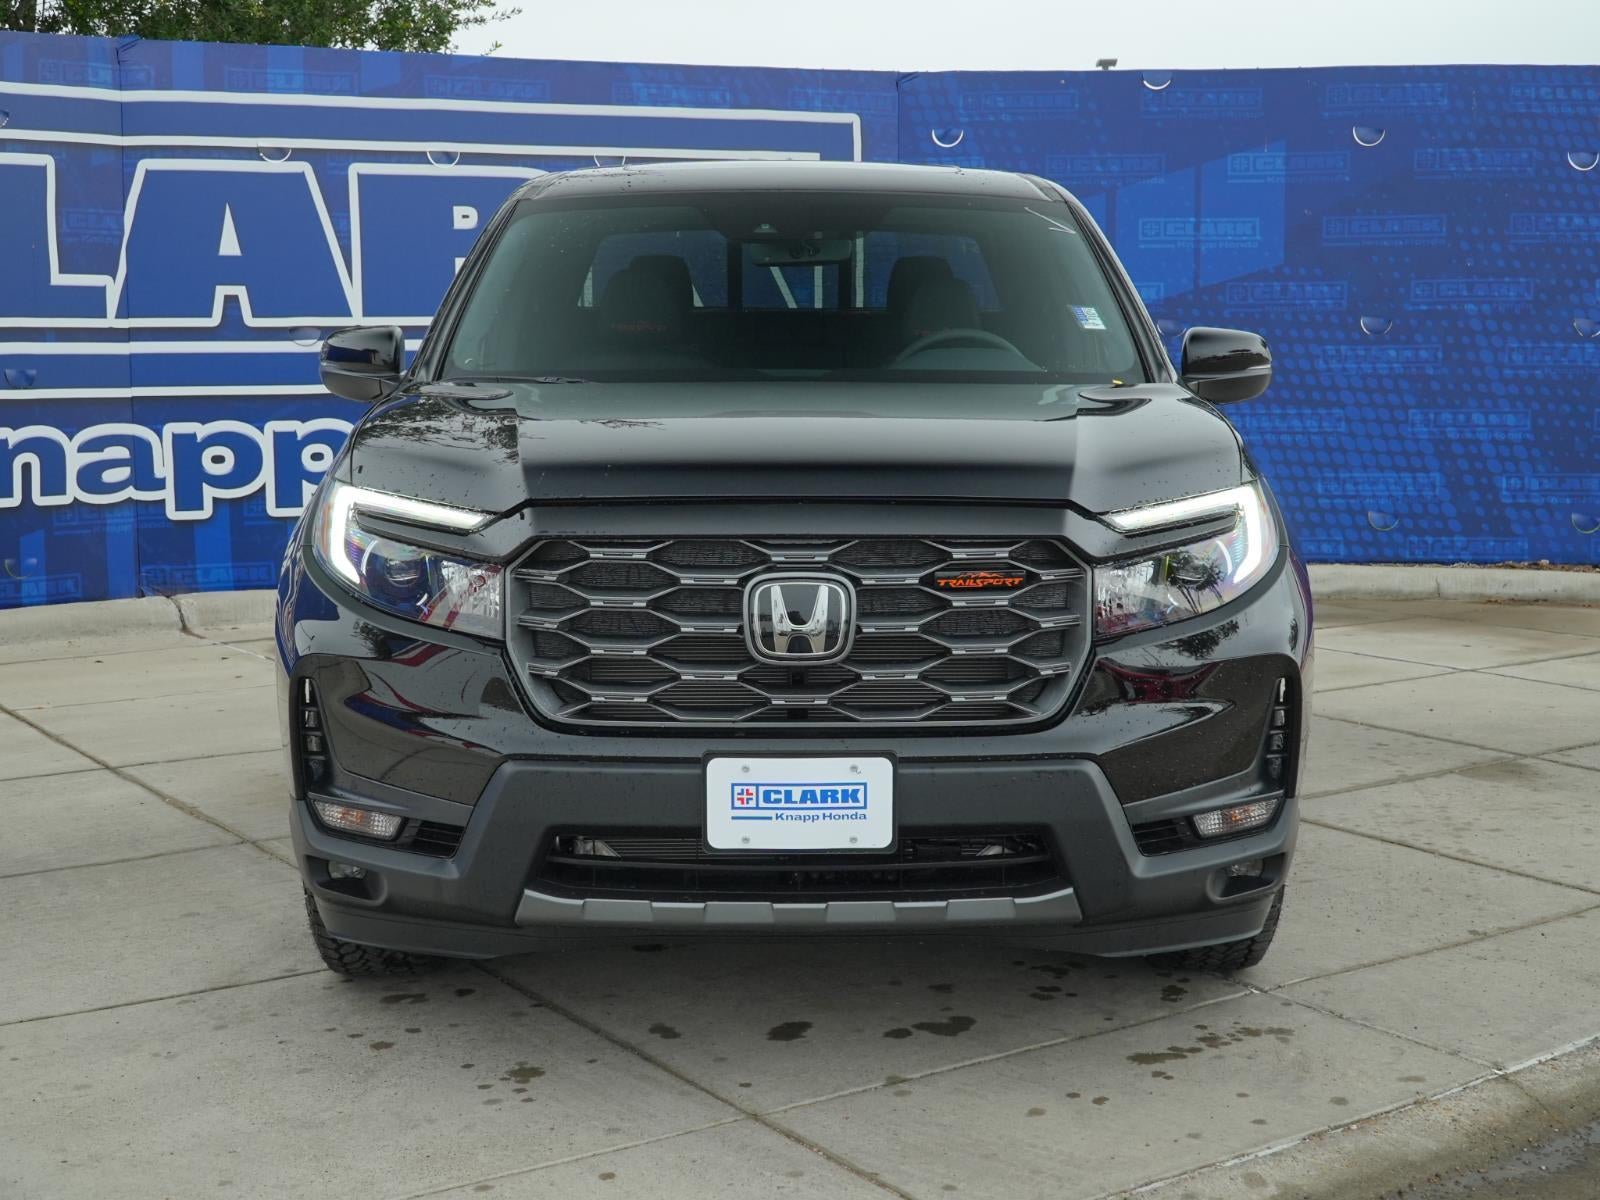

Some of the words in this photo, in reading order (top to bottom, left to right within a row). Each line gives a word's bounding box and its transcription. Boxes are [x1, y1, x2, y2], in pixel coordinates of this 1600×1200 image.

[0, 154, 552, 328] LAR
[0, 418, 354, 520] napp
[937, 577, 1024, 588] TRAILSPORT
[762, 788, 861, 805] CLARK
[775, 812, 820, 823] Knapp
[822, 811, 867, 821] Honda
